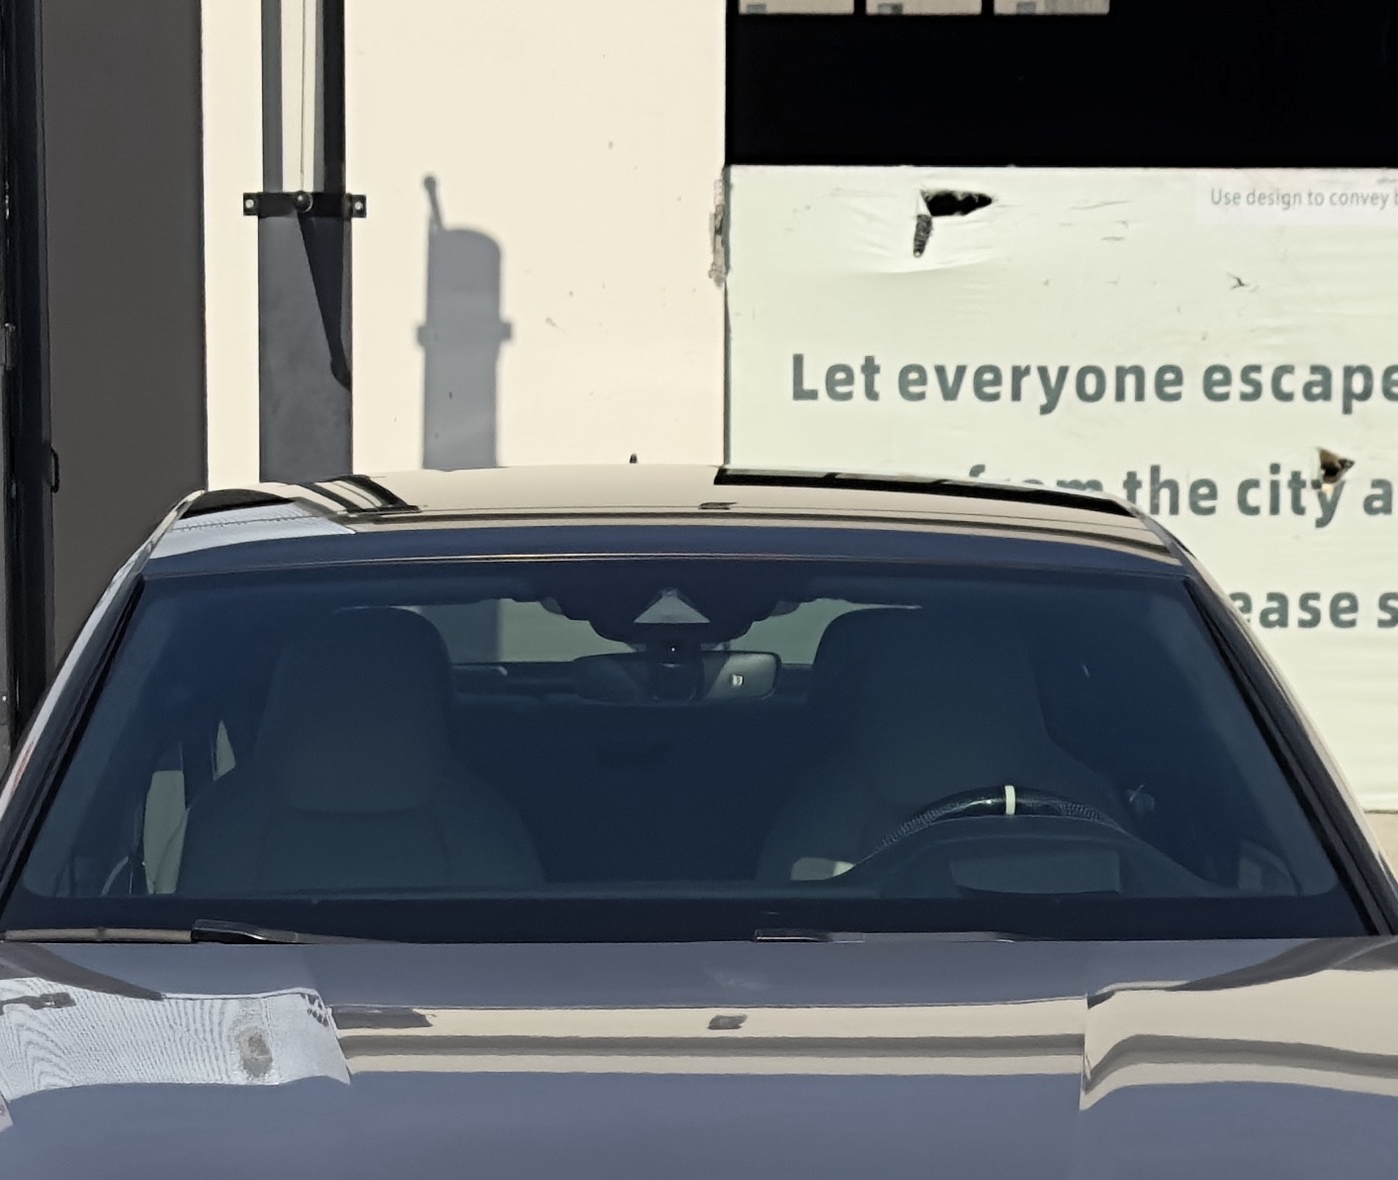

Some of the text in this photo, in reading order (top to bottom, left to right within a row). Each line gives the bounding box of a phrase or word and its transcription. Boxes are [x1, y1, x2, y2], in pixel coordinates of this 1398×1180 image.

[1210, 187, 1242, 207] Use
[1246, 186, 1303, 212] design
[1307, 189, 1325, 207] to
[1329, 191, 1390, 212] convey
[792, 353, 881, 402] Let
[898, 363, 1184, 416] everyone
[1123, 464, 1218, 516] the
[1237, 462, 1346, 529] city
